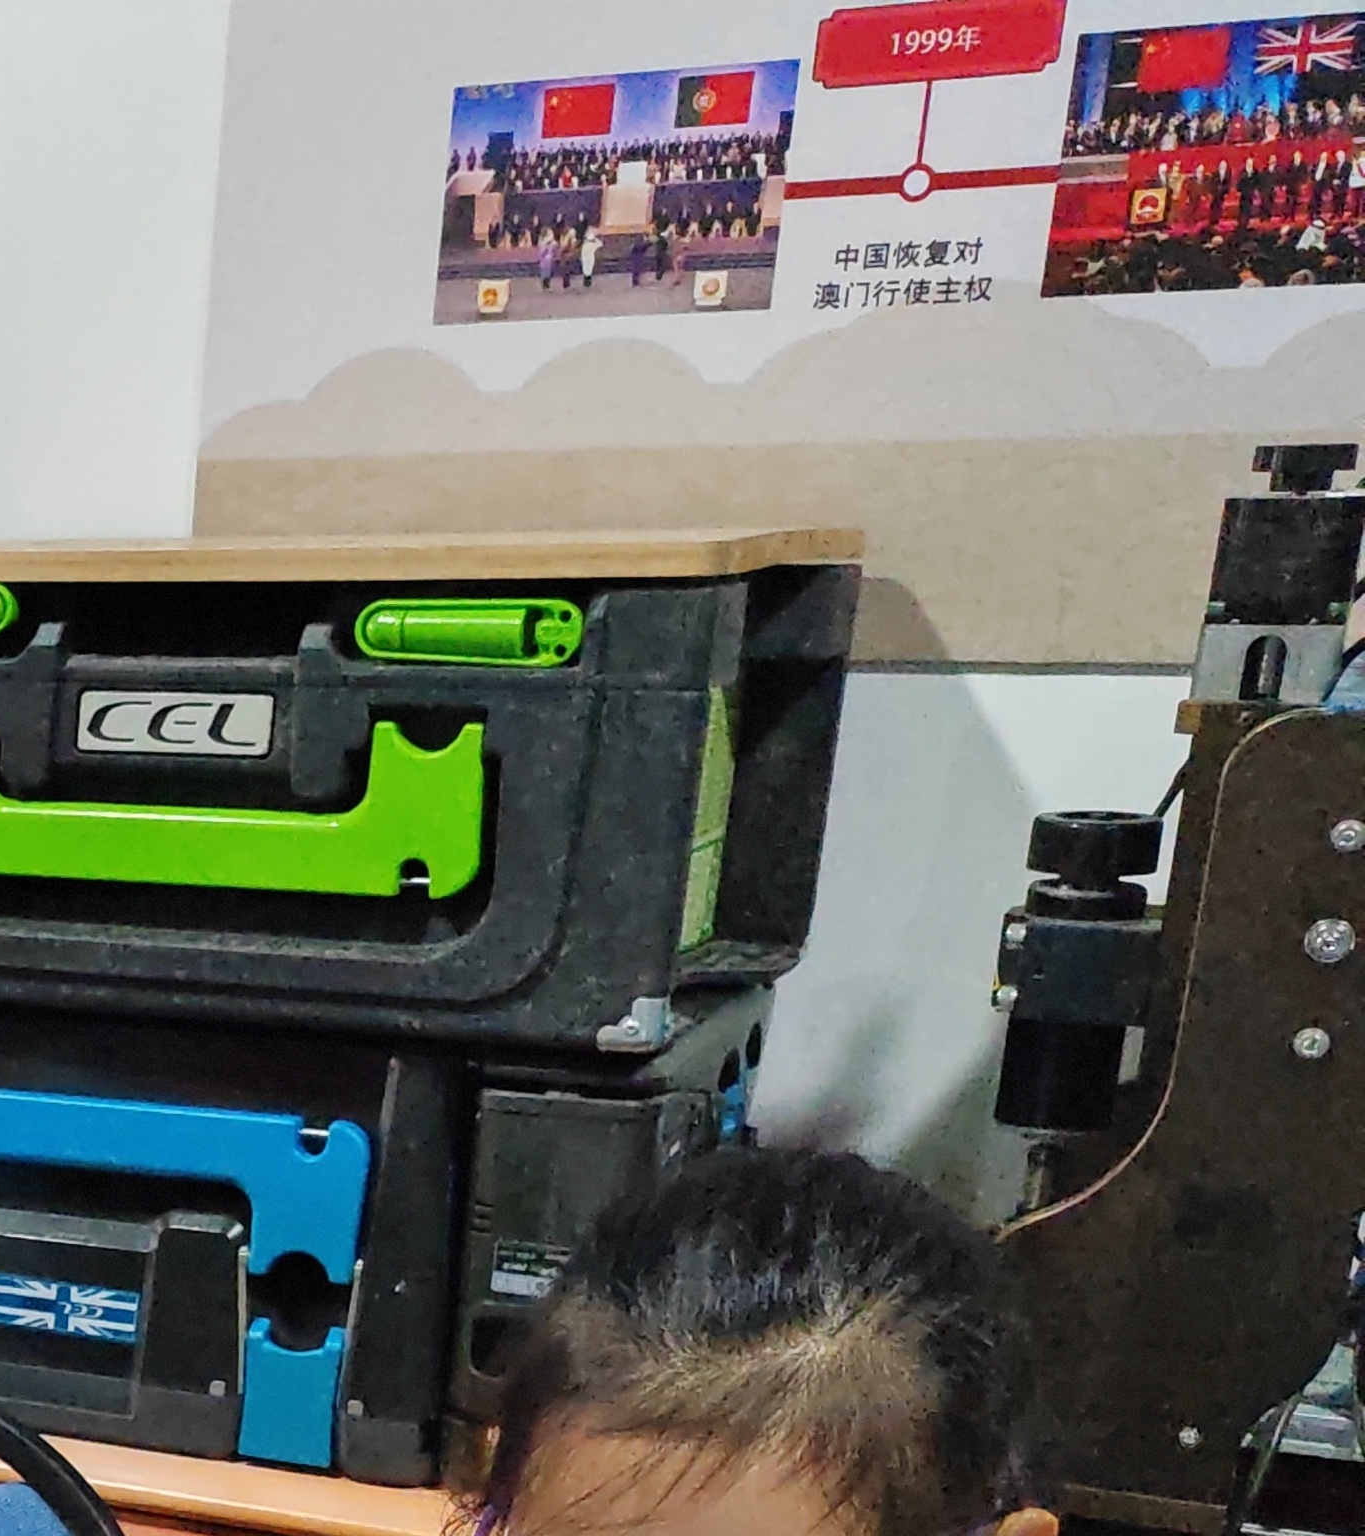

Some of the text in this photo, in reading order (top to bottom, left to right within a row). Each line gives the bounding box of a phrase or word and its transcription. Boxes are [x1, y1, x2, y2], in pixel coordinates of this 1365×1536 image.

[889, 24, 982, 56] 1999年
[834, 236, 984, 272] 中国恢复对
[812, 273, 994, 310] 澳门行使主权
